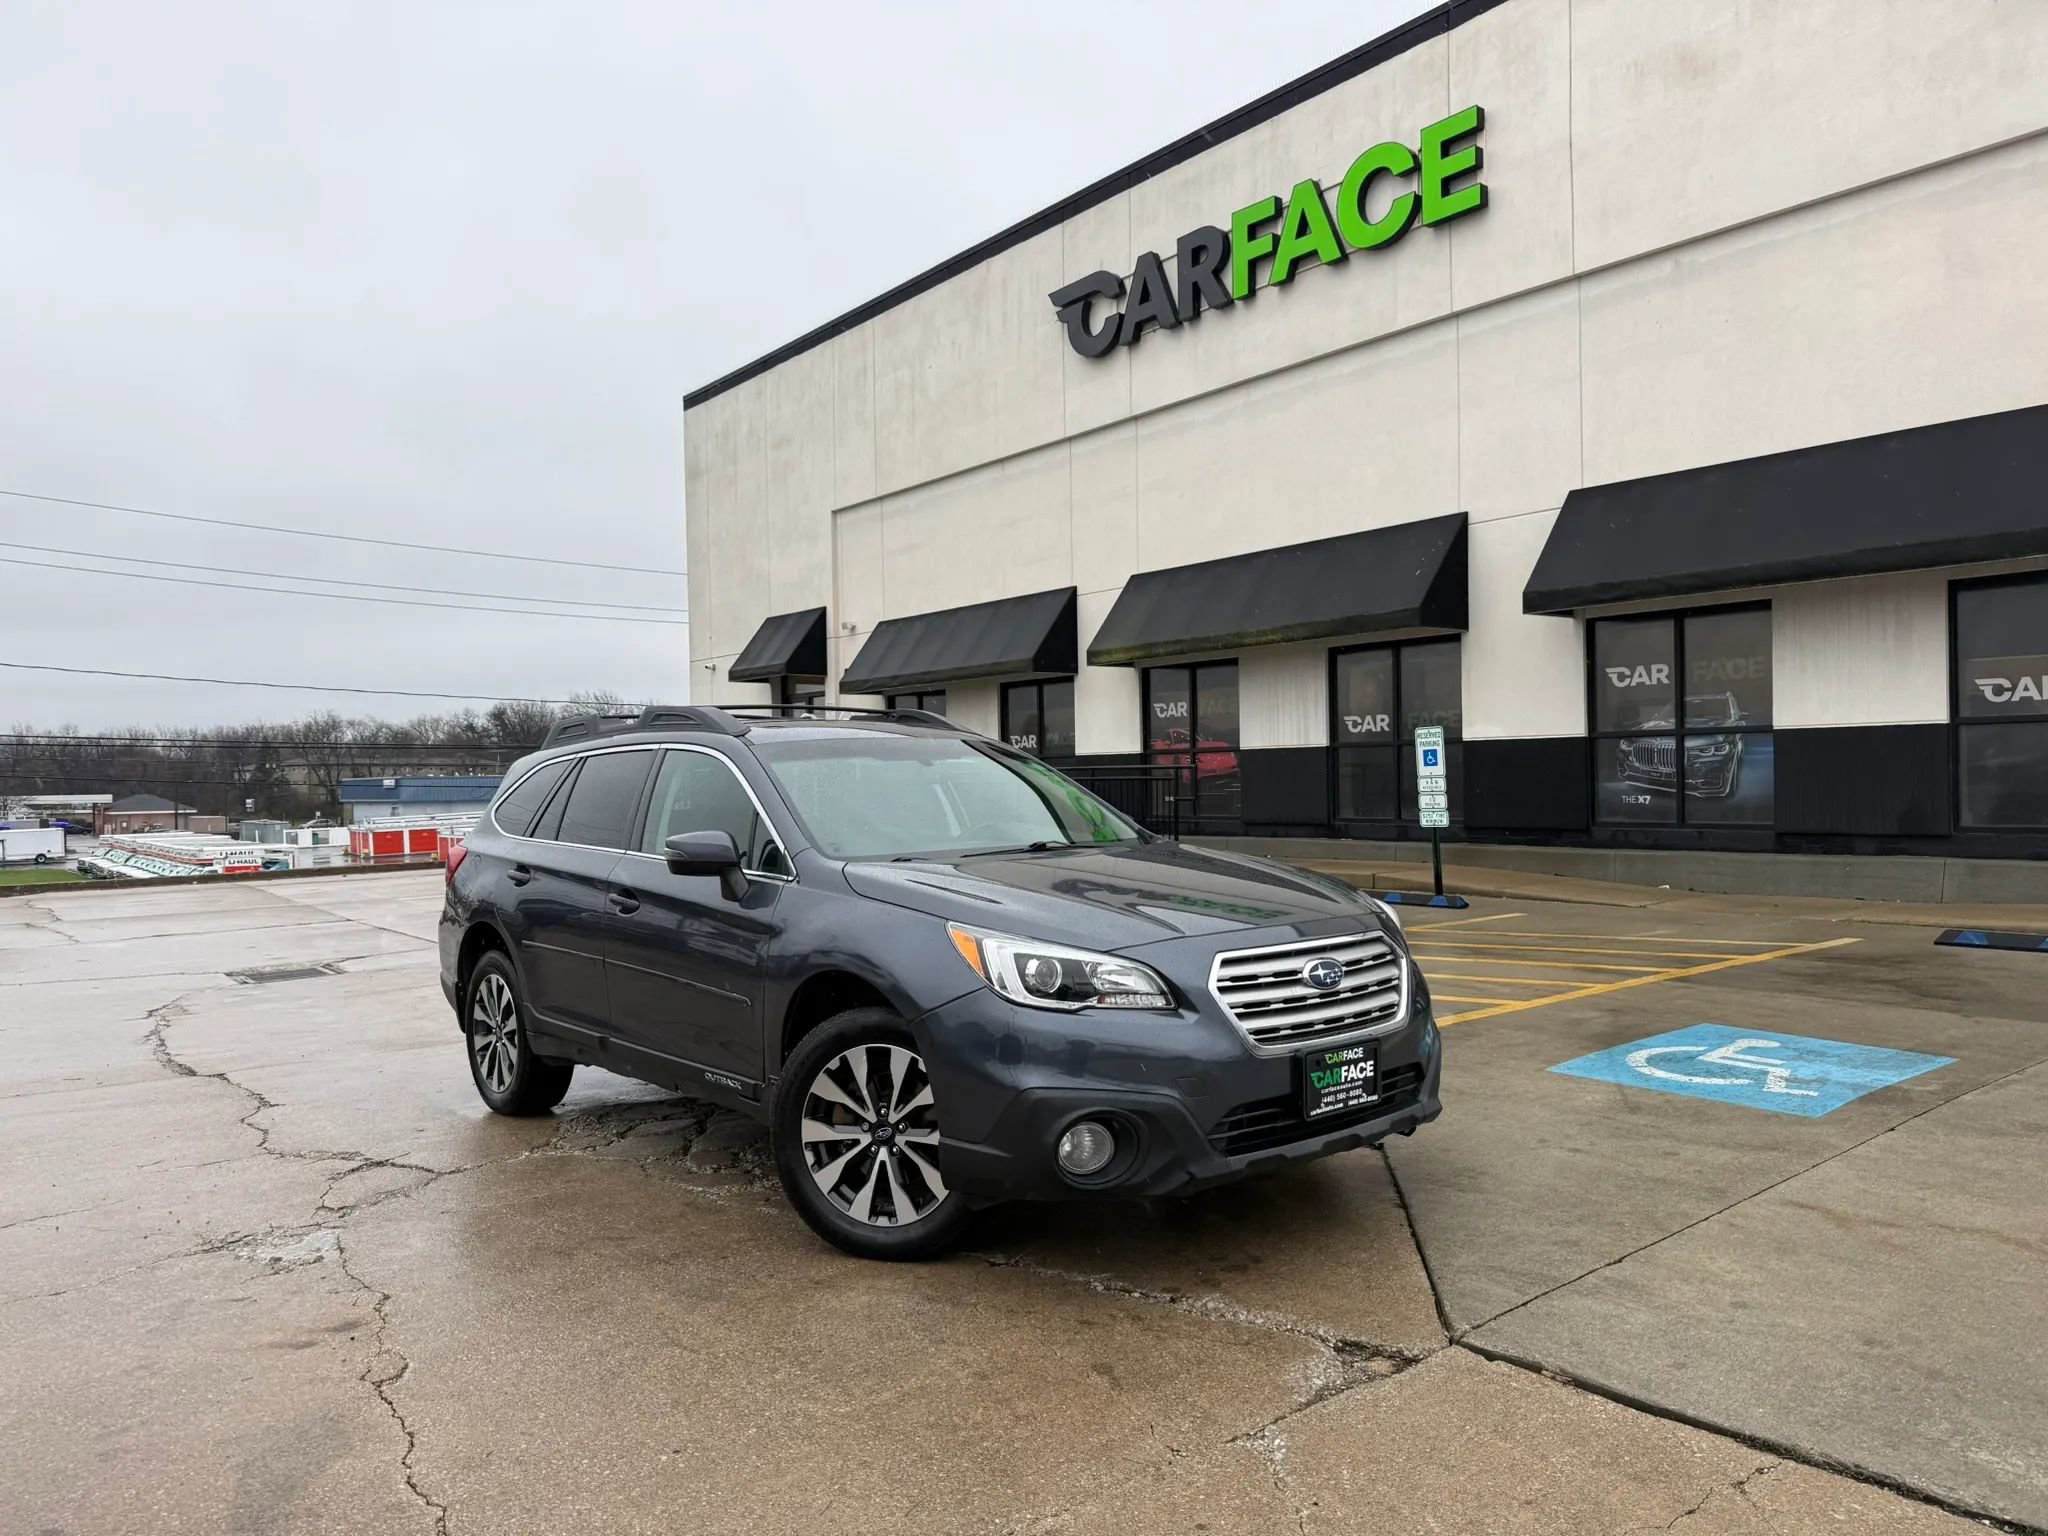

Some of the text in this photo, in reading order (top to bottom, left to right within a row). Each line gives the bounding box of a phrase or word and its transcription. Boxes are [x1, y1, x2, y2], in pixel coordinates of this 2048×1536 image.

[1049, 105, 1488, 358] CARFACE
[1605, 663, 1670, 688] CAR
[1153, 701, 1188, 718] CAR
[1343, 714, 1390, 733] CAR
[1010, 735, 1037, 749] CAR
[1417, 731, 1441, 739] RESERVED
[1419, 740, 1440, 748] PARKING
[1621, 795, 1651, 804] THE X7
[1324, 1047, 1364, 1064] CARFACE
[1310, 1060, 1374, 1089] CARFACE
